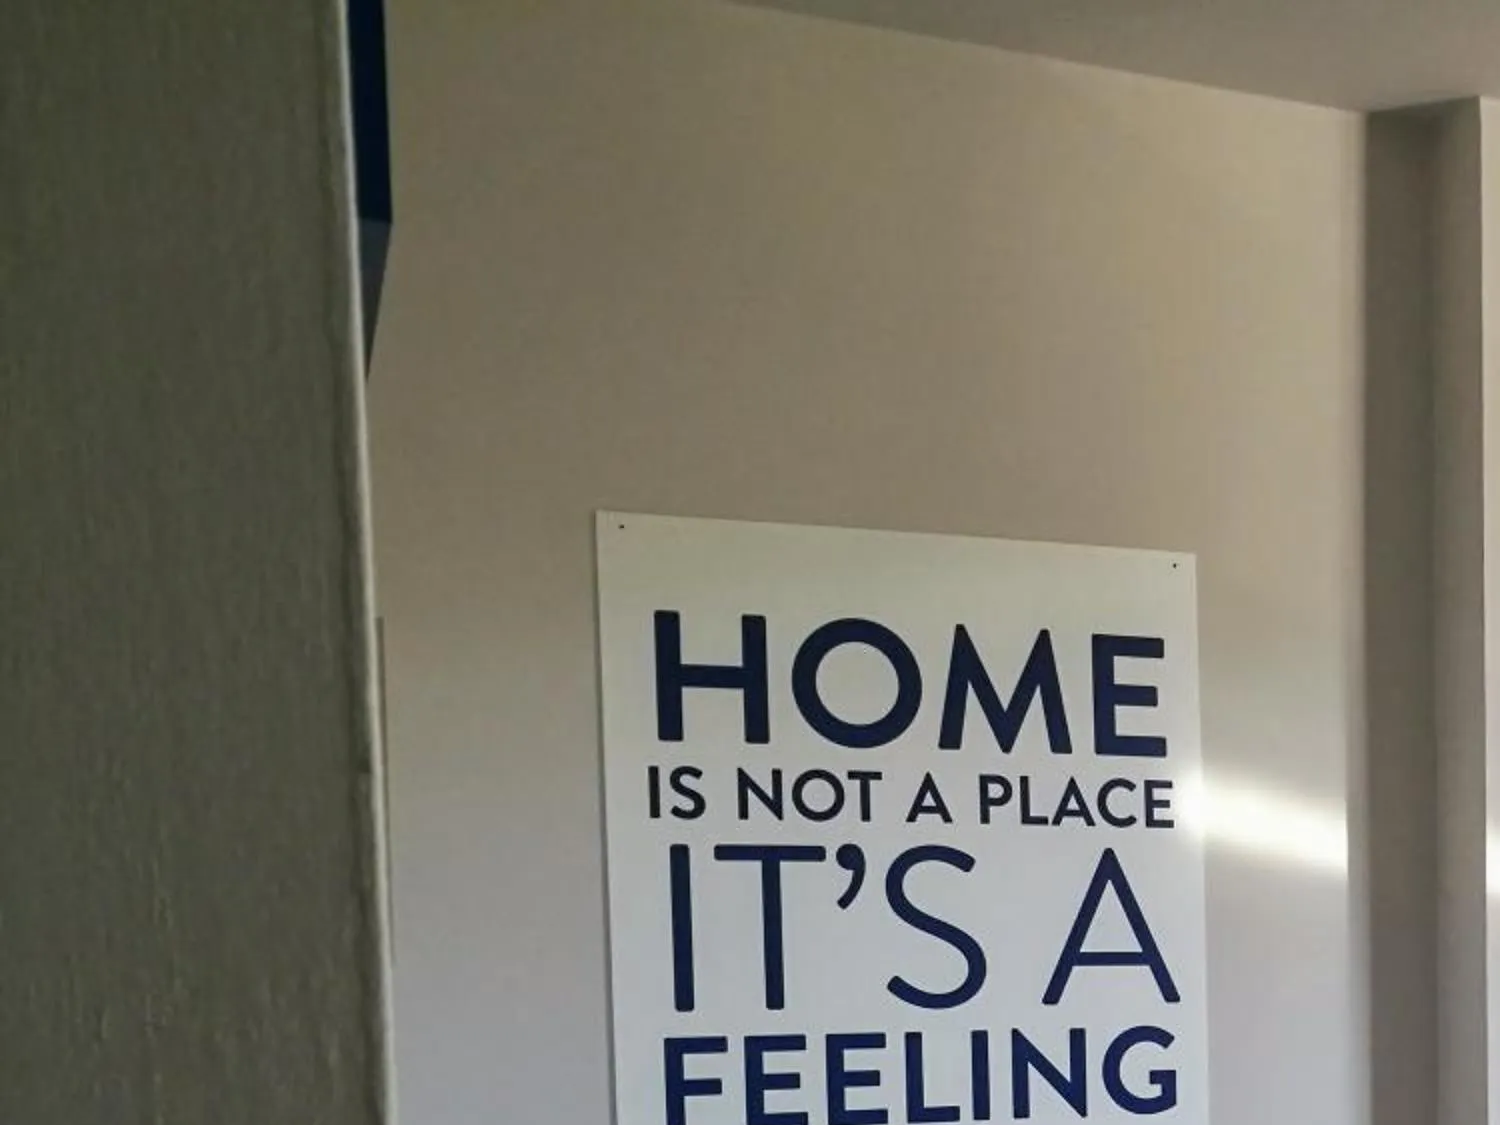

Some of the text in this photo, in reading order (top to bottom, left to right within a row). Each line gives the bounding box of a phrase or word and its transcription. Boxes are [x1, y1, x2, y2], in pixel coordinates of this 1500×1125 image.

[653, 609, 1168, 759] HOME
[647, 764, 1175, 830] IS NOT A PLACE
[668, 842, 1182, 1014] IT'S A
